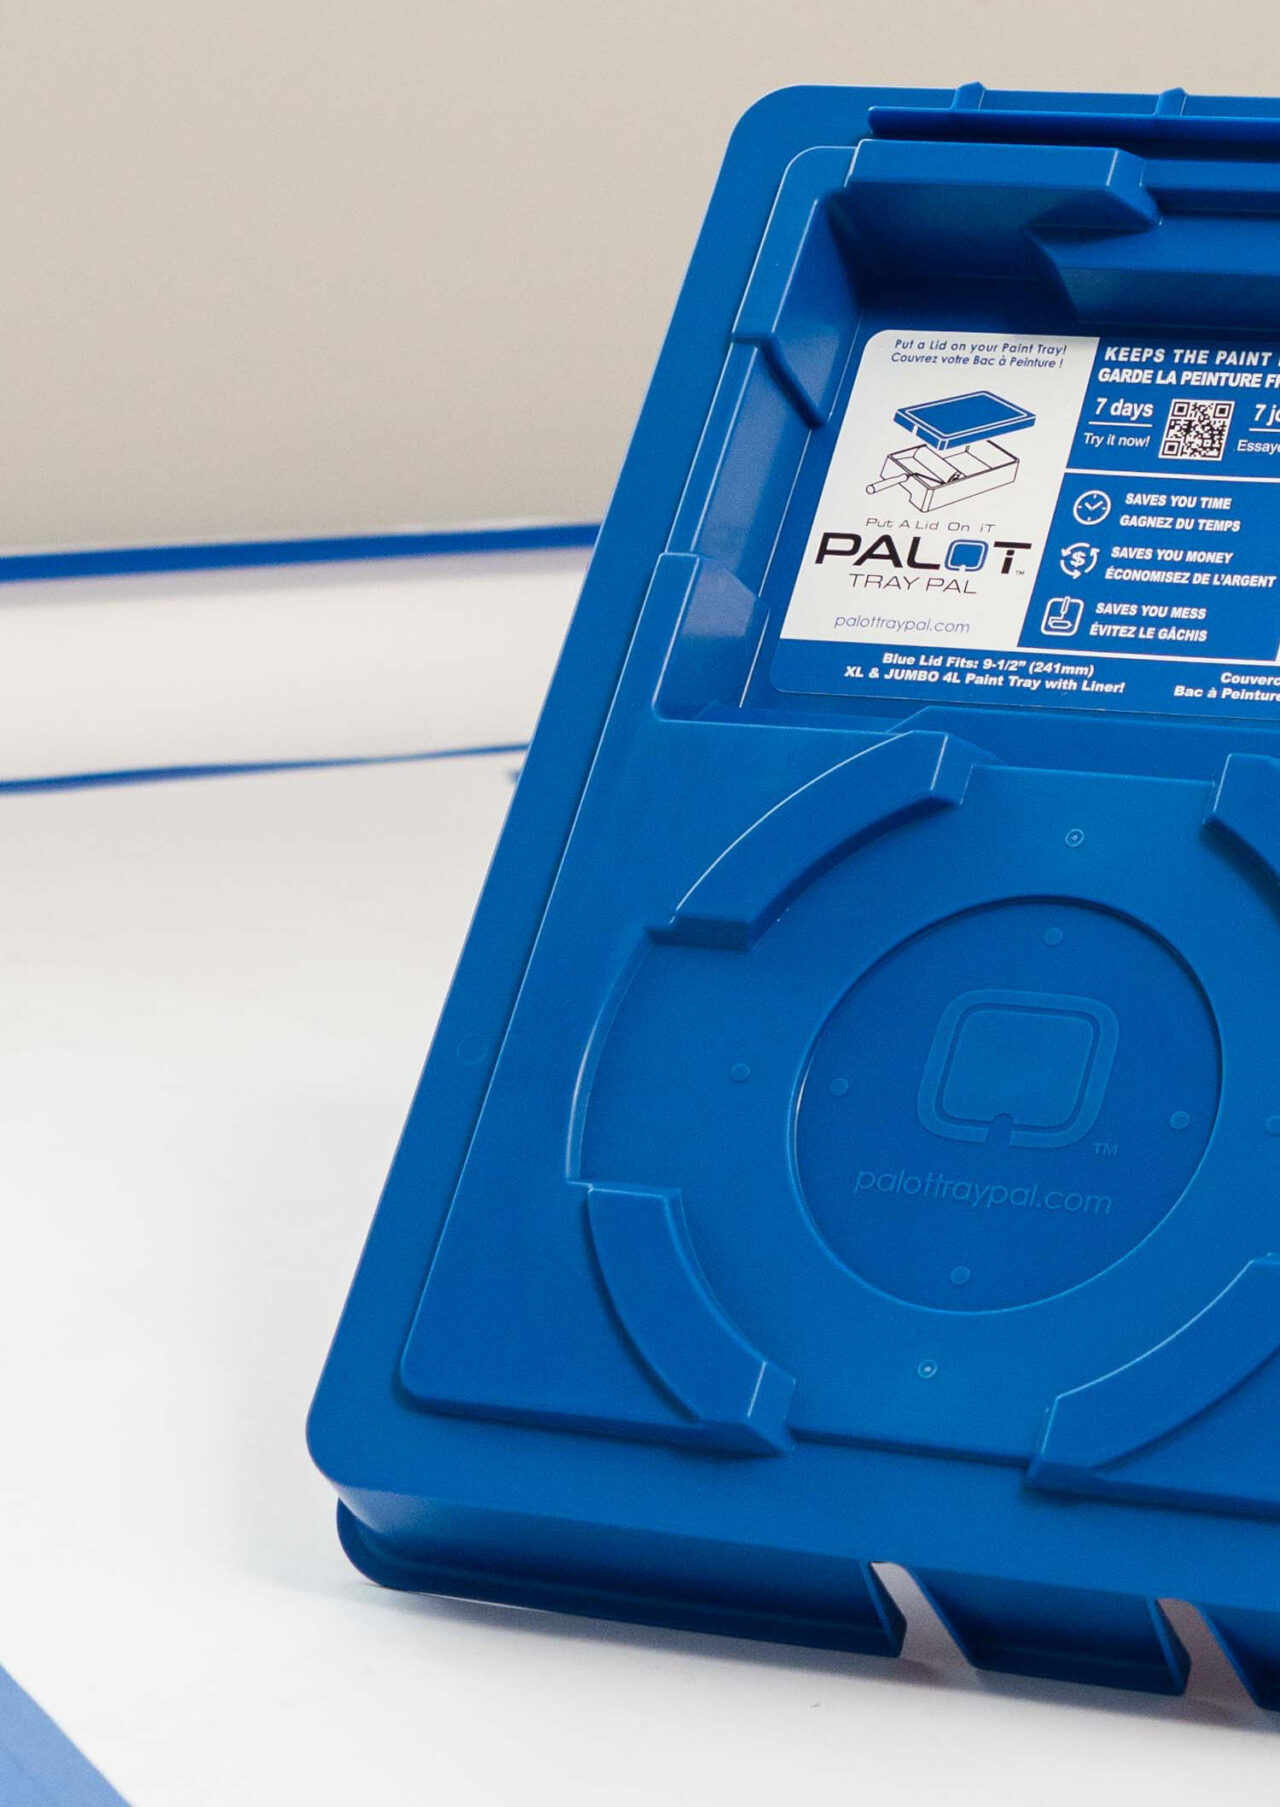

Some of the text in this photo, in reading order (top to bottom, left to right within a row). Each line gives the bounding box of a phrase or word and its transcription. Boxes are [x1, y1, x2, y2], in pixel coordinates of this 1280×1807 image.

[894, 338, 1067, 356] Put a Lid on your Paint Tray!
[1104, 346, 1165, 362] KEEPS
[1173, 349, 1209, 364] THE
[1215, 350, 1272, 366] PAINT
[890, 351, 938, 363] Couvrez
[941, 354, 969, 364] votre
[972, 354, 995, 365] Bac
[998, 354, 1006, 366] à
[1009, 356, 1056, 368] Peinture
[1097, 367, 1153, 383] GARDE
[1155, 369, 1176, 384] LA
[1179, 370, 1263, 387] PEINTURE
[1095, 397, 1153, 421] 7 days
[1254, 403, 1266, 421] 7
[1083, 432, 1150, 447] Try it now!
[1124, 492, 1232, 509] SAVES YOU TIME
[865, 517, 893, 528] Put
[898, 519, 910, 528] A
[915, 520, 939, 530] Lid
[947, 521, 970, 531] On
[1119, 514, 1240, 532] GAGNEZ DU TEMPS
[814, 531, 1032, 574] PALOT
[1110, 545, 1233, 563] SAVES YOU MONEY
[848, 572, 976, 594] TRAY PAL
[1104, 566, 1191, 583] ÉCONOMISEZ
[1191, 572, 1211, 584] DE
[1095, 602, 1206, 619] SAVES YOU MESS
[833, 614, 970, 632] palottraypal.com
[1089, 621, 1137, 637] ÉVITEZ
[1137, 626, 1156, 639] LE
[881, 652, 915, 664] Blue
[918, 654, 943, 666] Lid
[945, 656, 979, 669] Fits:
[1028, 660, 1094, 678] (241mm)
[843, 665, 1125, 693] XL & JUMBO 4L Paint Tray with Liner!
[1173, 684, 1203, 697] Bac
[1206, 686, 1217, 698] à
[854, 1168, 1112, 1215] palottraypal.com
